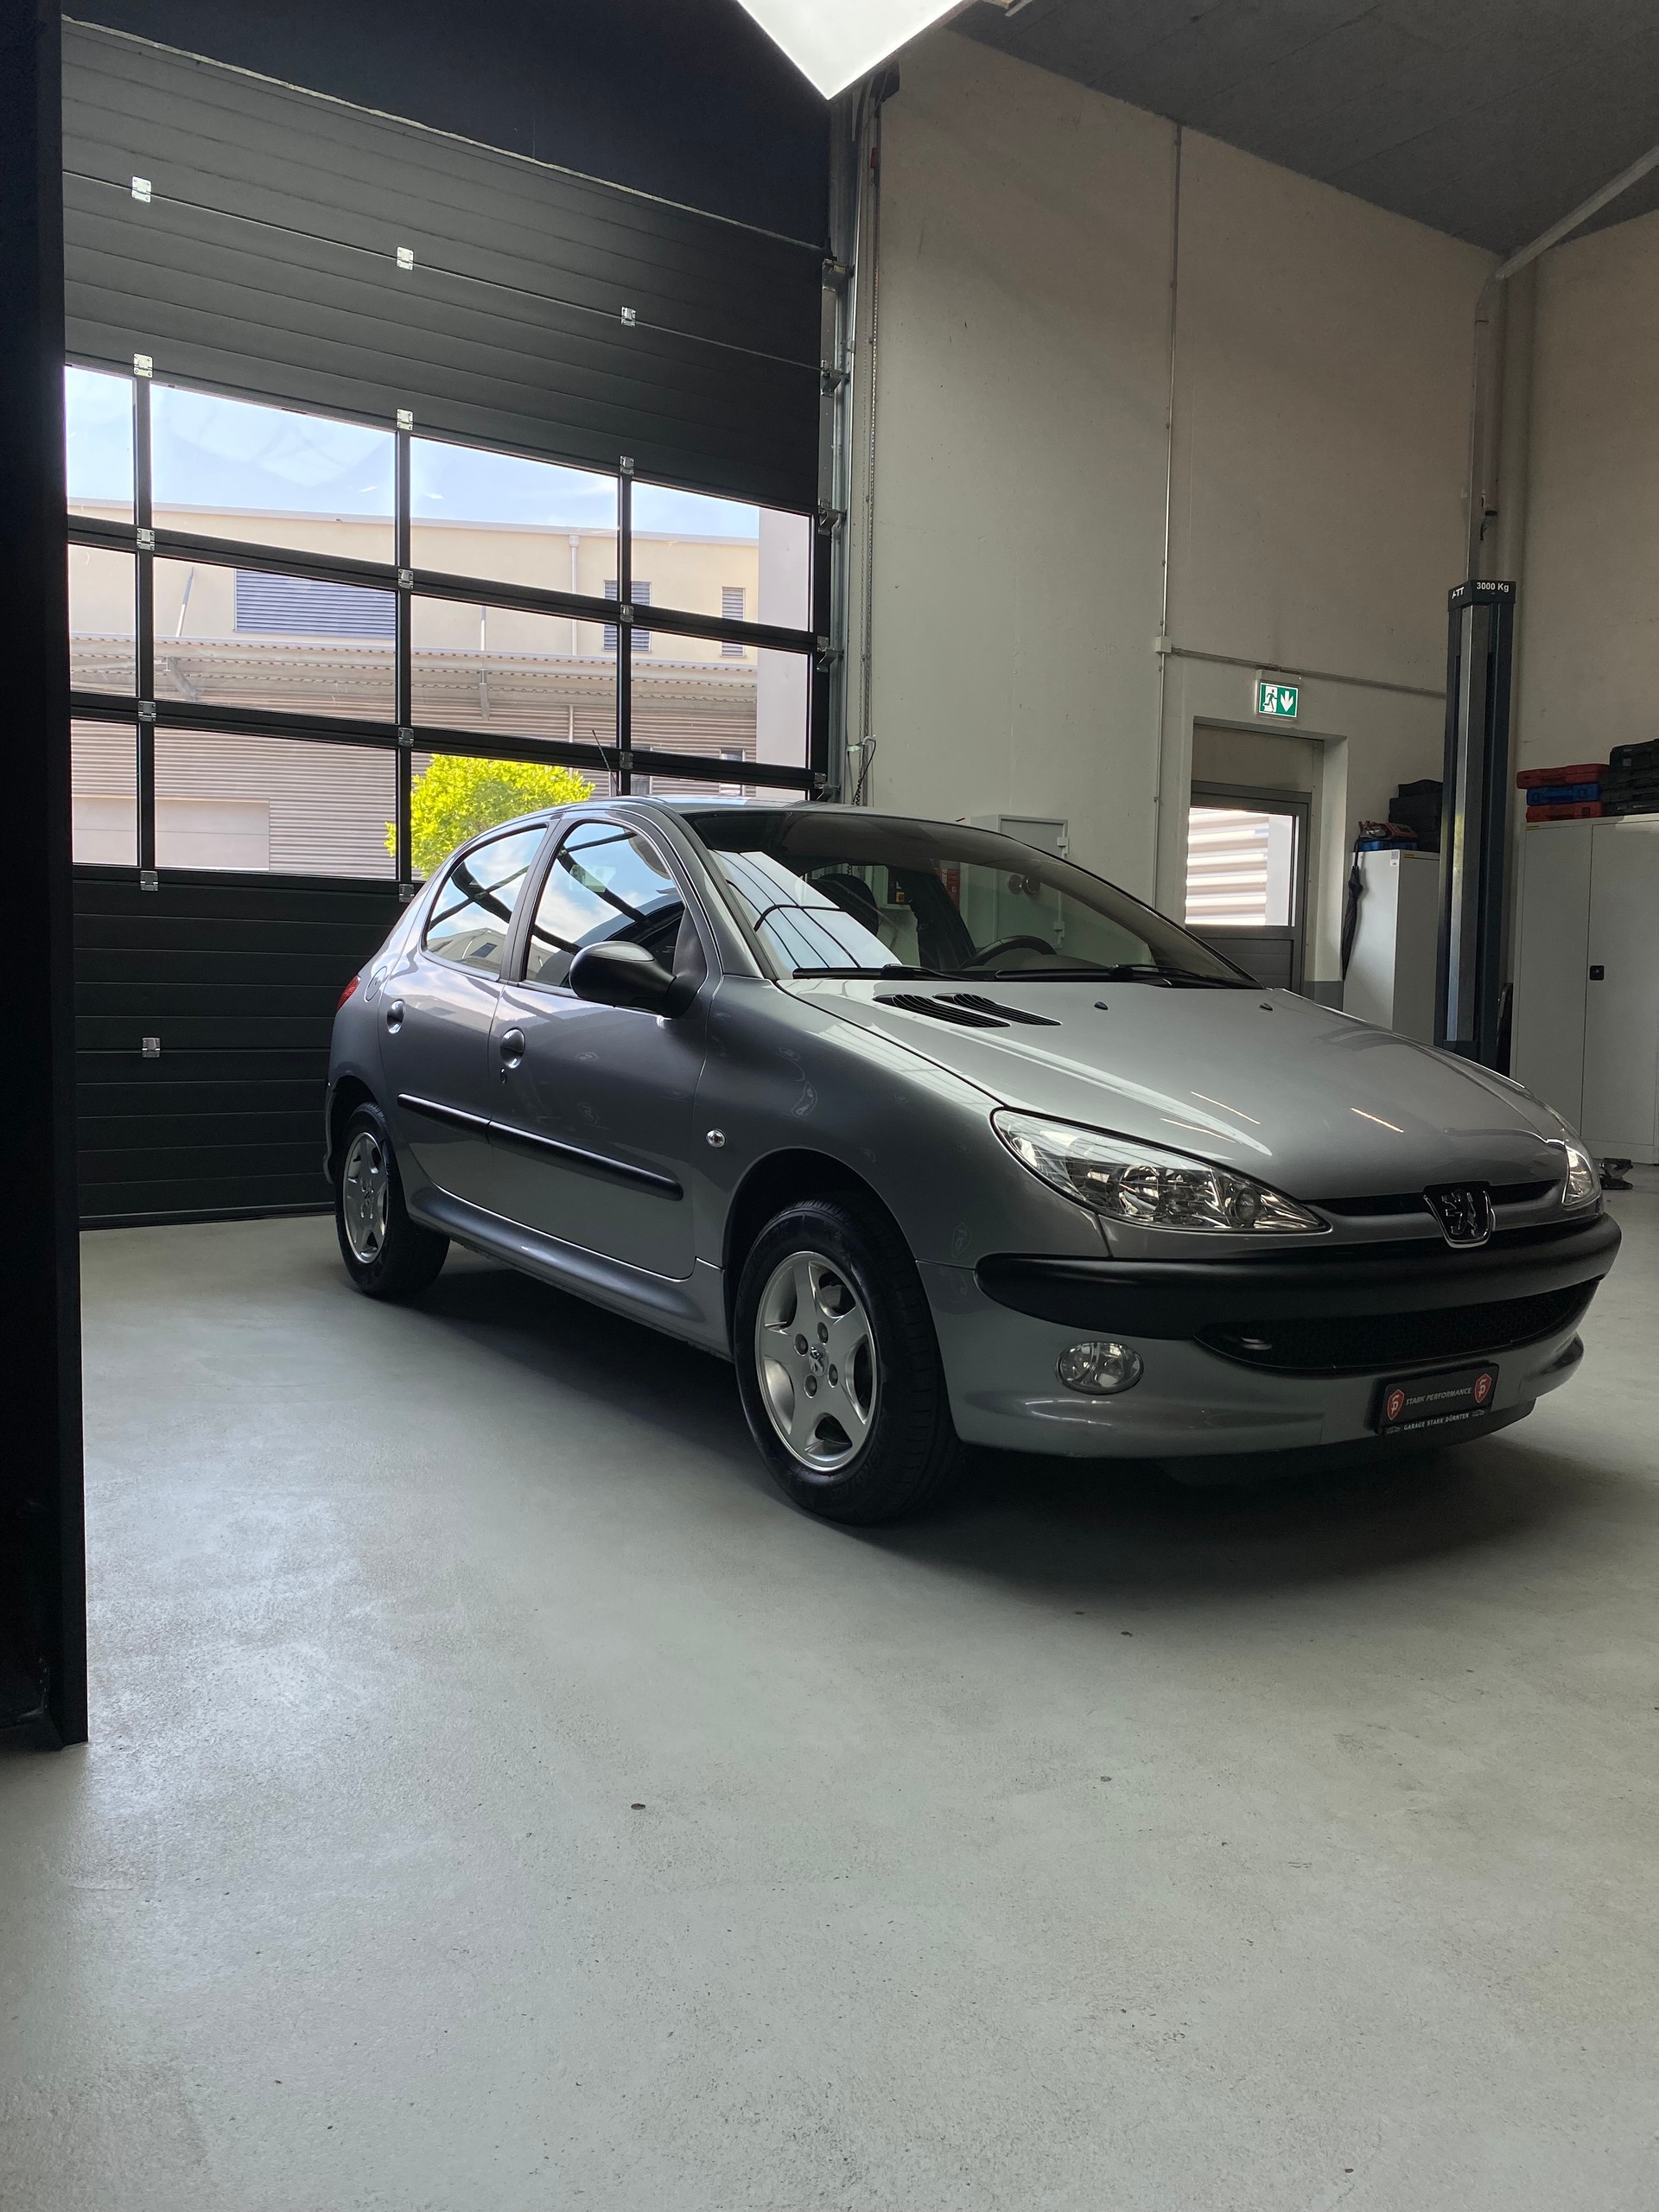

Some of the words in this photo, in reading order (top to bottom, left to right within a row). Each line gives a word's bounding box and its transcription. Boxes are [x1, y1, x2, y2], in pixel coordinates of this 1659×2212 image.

[1476, 582, 1496, 590] 3000
[1497, 582, 1510, 593] Kg
[1405, 1395, 1426, 1406] STARK
[1426, 1387, 1472, 1402] PERFORMANCE
[1403, 1421, 1425, 1431] GARAGE
[1427, 1418, 1444, 1427] STARK
[1445, 1412, 1470, 1422] DÜRNTEN
